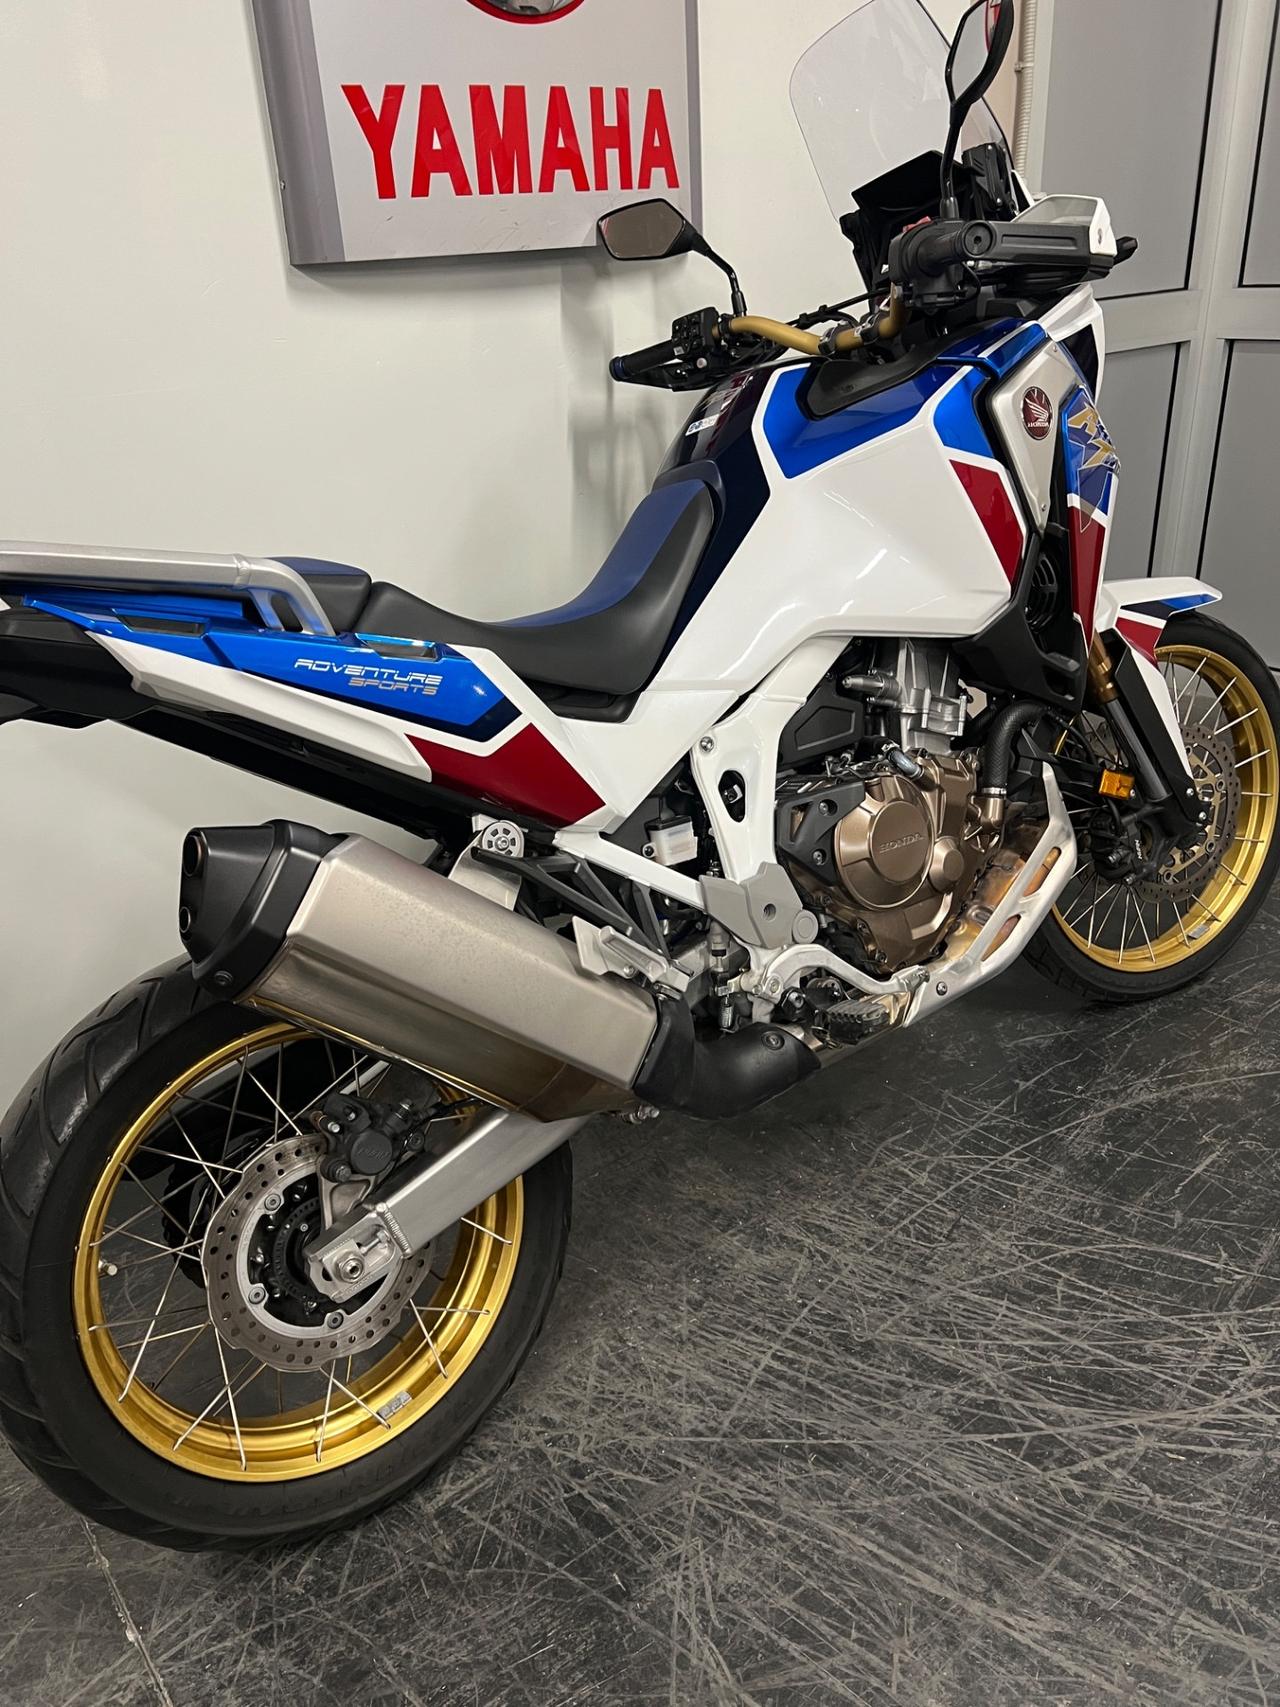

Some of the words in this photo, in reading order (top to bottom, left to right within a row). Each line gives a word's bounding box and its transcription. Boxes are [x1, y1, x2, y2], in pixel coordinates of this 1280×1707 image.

[341, 84, 680, 199] YAMAHA
[294, 658, 443, 685] ADVENTURE
[348, 678, 439, 695] SPORTS
[879, 833, 924, 852] HONDA
